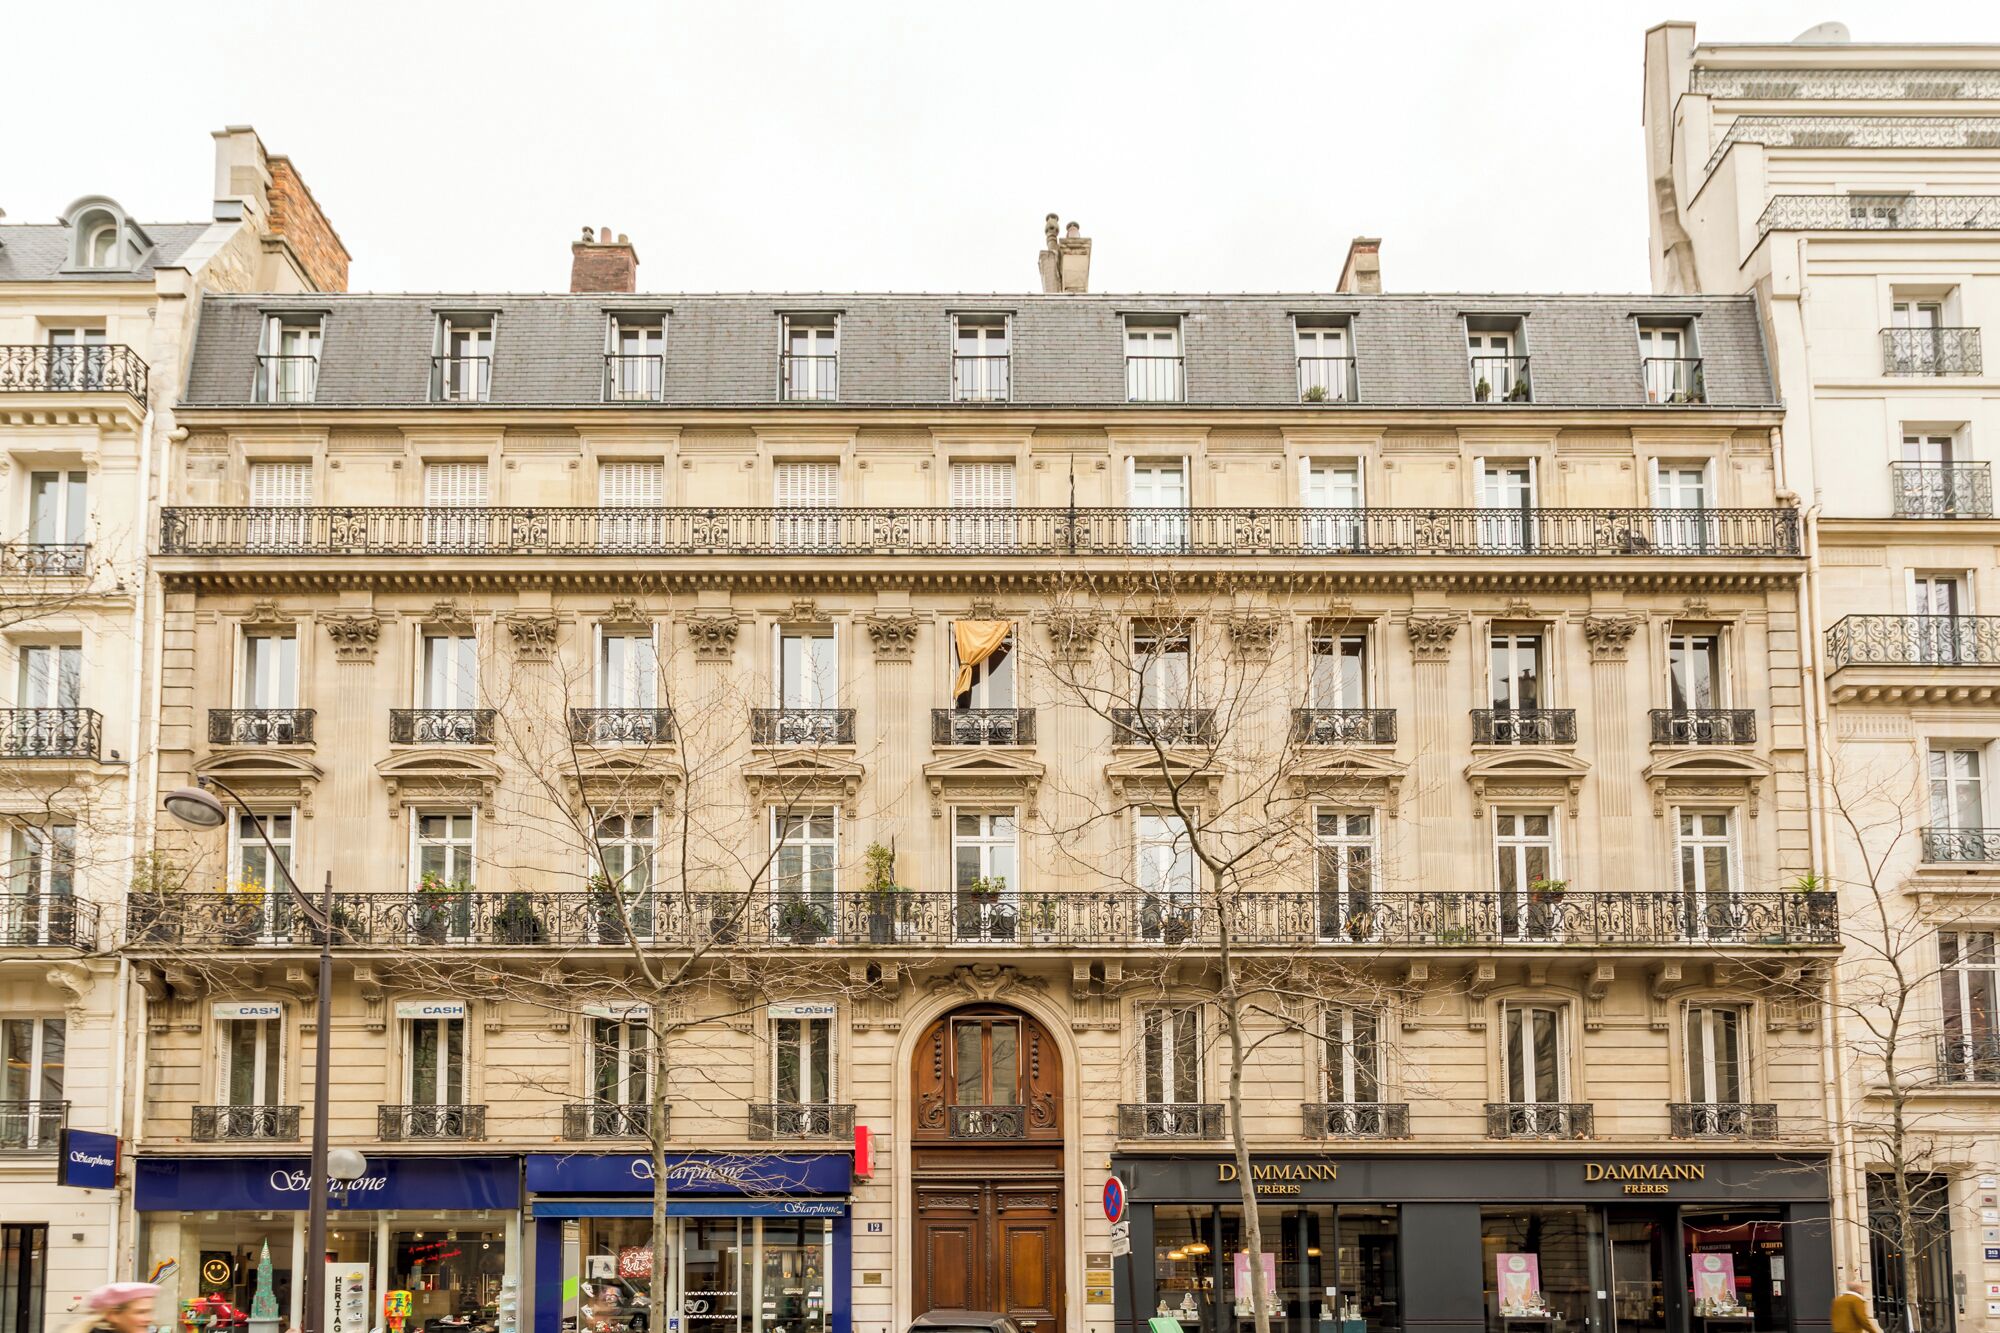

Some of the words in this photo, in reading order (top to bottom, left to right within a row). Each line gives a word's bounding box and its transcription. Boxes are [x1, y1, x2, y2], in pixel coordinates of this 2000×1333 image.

[240, 1007, 279, 1015] CASH
[70, 1151, 114, 1168] Starphone
[1218, 1163, 1338, 1181] DMMANN
[1584, 1163, 1705, 1181] DAMMANN
[1256, 1182, 1301, 1194] FRÈRES
[1624, 1182, 1669, 1194] FRÈRES
[784, 1202, 839, 1216] Starphone
[870, 1223, 880, 1231] 12
